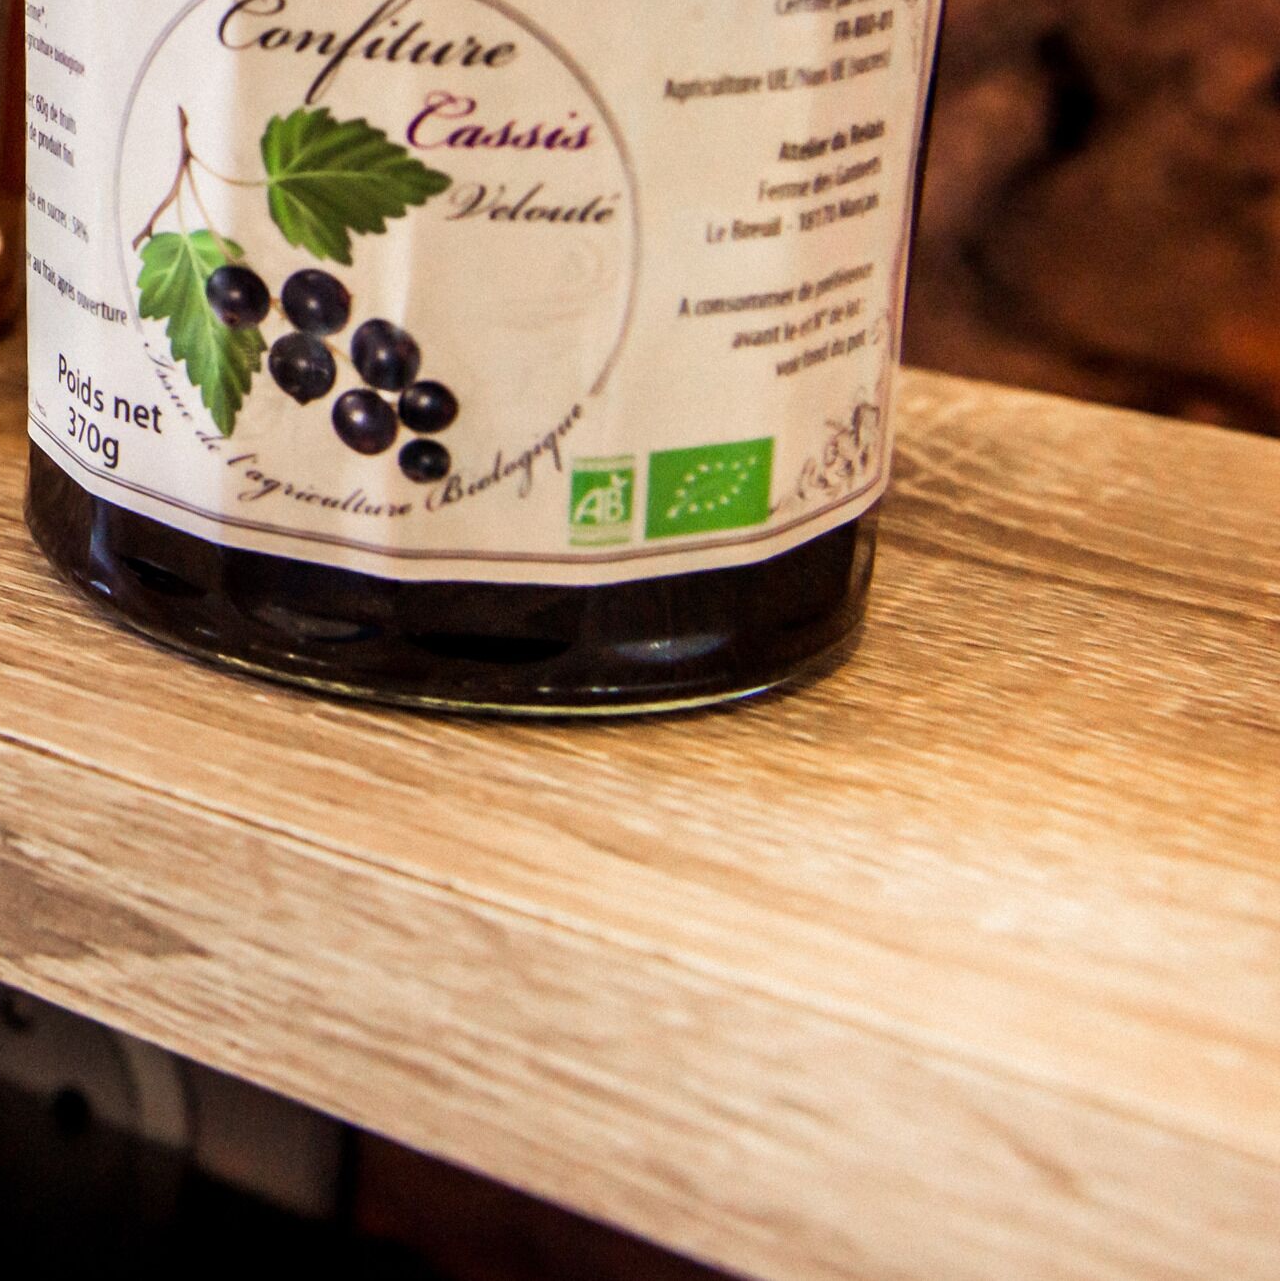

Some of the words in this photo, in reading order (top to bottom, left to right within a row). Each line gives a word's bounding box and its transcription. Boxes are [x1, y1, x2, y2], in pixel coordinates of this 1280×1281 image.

[35, 94, 49, 122] 60g
[405, 89, 595, 151] Cassis
[446, 181, 621, 225] Velouté
[76, 288, 128, 326] ouverture
[58, 352, 105, 414] Poids
[113, 394, 163, 435] net
[67, 405, 121, 470] 370g
[426, 401, 585, 513] Biologique
[572, 472, 628, 526] AB
